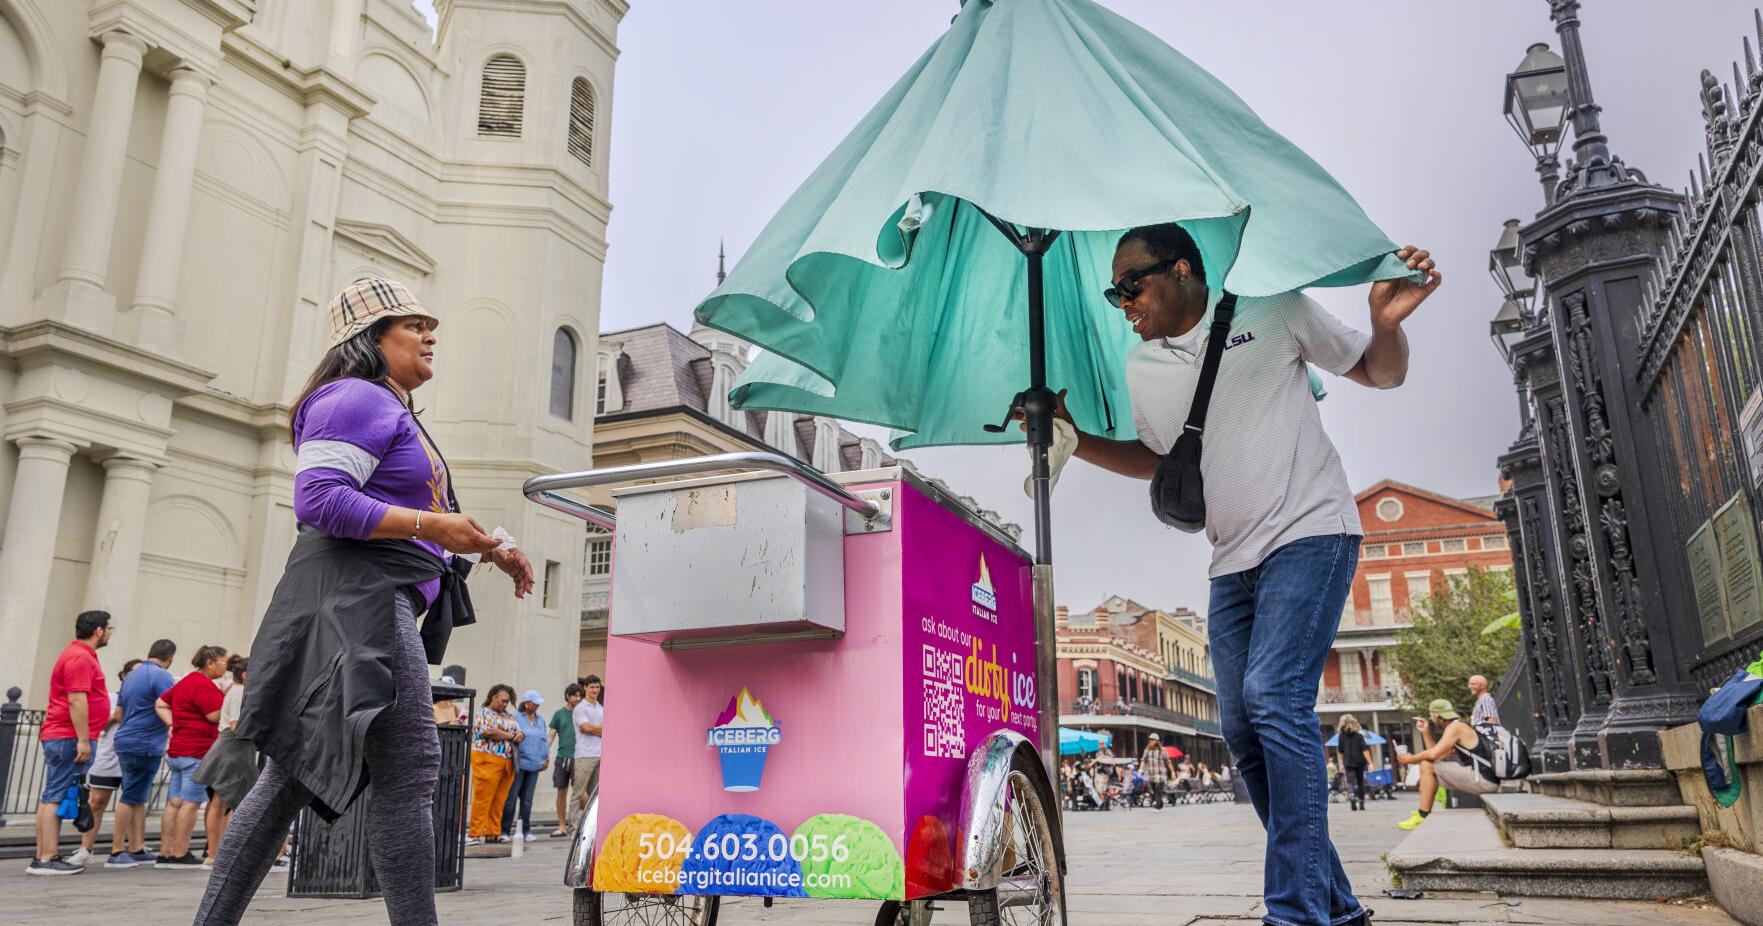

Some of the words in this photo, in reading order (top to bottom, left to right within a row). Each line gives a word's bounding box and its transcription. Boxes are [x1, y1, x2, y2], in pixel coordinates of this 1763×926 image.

[921, 616, 936, 635] ask
[937, 620, 959, 643] about
[960, 632, 972, 647] our
[990, 612, 998, 624] ICE
[964, 636, 1012, 723] dirty
[1012, 652, 1036, 709] ice
[975, 699, 986, 717] for
[986, 704, 1001, 723] your
[1010, 711, 1023, 726] next
[707, 727, 782, 746] ICEBERG
[638, 832, 850, 863] 504.603.0056
[637, 866, 851, 889] icebergitalianice.com
